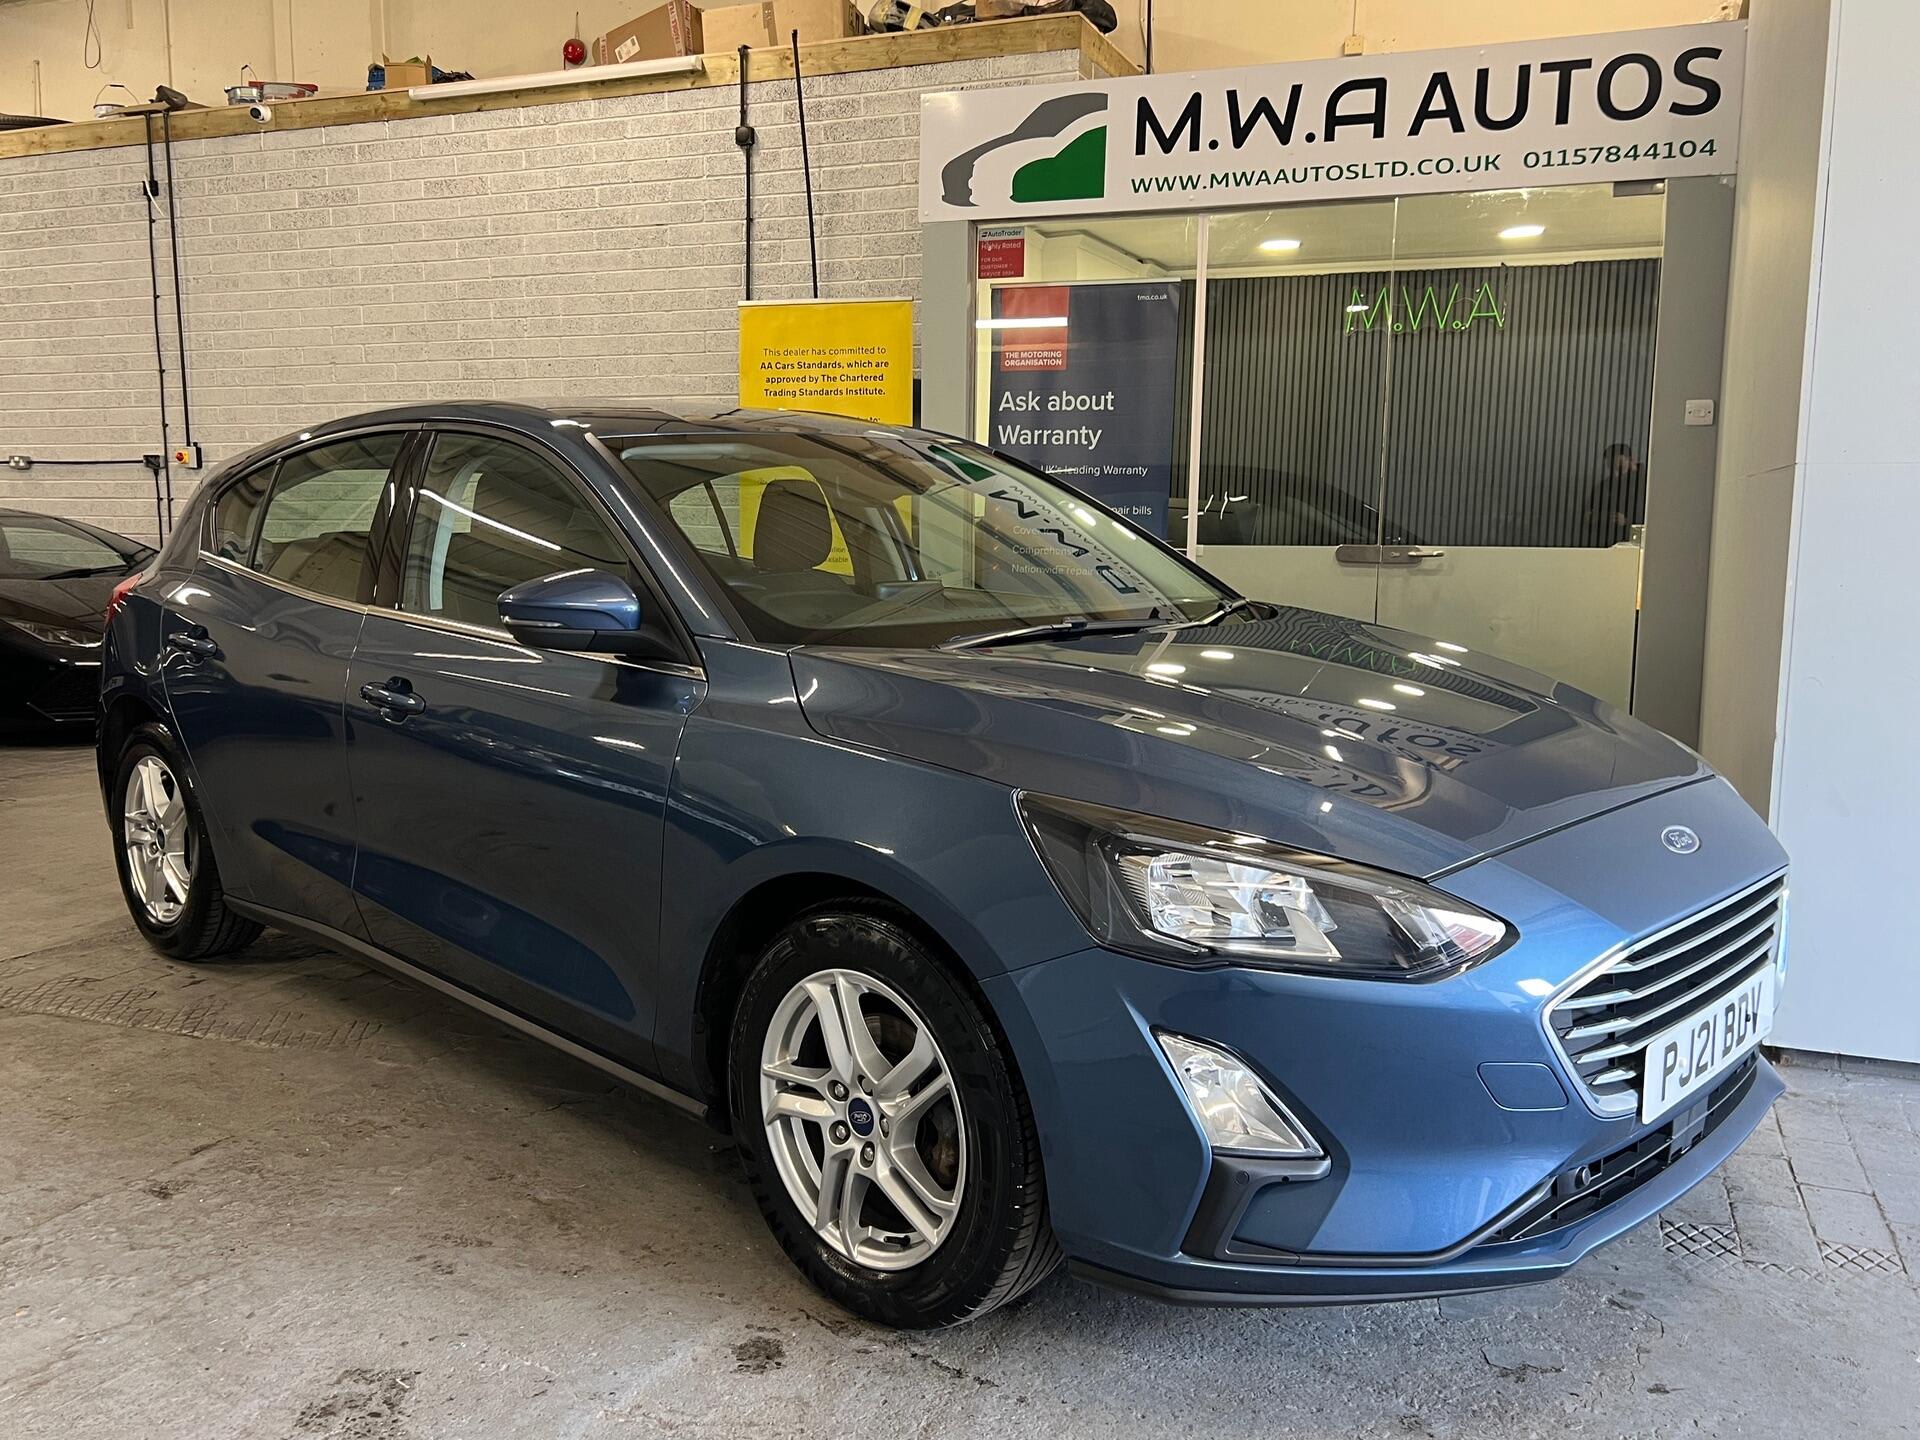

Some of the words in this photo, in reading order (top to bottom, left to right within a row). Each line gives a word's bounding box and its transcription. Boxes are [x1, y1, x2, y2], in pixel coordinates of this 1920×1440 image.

[1135, 77, 1388, 156] M.W.A
[1407, 46, 1723, 136] AUTOS
[1131, 154, 1501, 194] WWW.MWAAUTOSLTD.CO.UK
[1522, 138, 1717, 168] 01157844104
[1346, 282, 1503, 334] M.W.A
[763, 348, 781, 357] This
[783, 347, 809, 357] dealer
[811, 347, 827, 355] has
[828, 346, 875, 355] committed
[877, 346, 886, 354] to
[1020, 351, 1062, 359] MOTORING
[760, 361, 773, 370] AA
[775, 361, 795, 370] Cars
[797, 361, 844, 370] Standards,
[846, 360, 873, 368] which
[875, 360, 889, 368] are
[1004, 359, 1062, 367] ORGANISATION
[765, 375, 807, 385] approved
[808, 375, 819, 384] by
[821, 374, 838, 382] The
[839, 373, 884, 382] Chartered
[763, 388, 797, 398] Trading
[798, 388, 844, 397] Standards
[845, 387, 886, 396] Institute.
[998, 390, 1041, 412] Ask
[1047, 390, 1115, 412] about
[998, 424, 1103, 450] Warranty
[1103, 464, 1148, 477] Warranty
[1132, 505, 1152, 516] bills
[1012, 564, 1065, 575] Nationwide
[1066, 567, 1094, 576] repair
[1660, 1014, 1718, 1103] PJ21
[1721, 981, 1763, 1059] BDV
